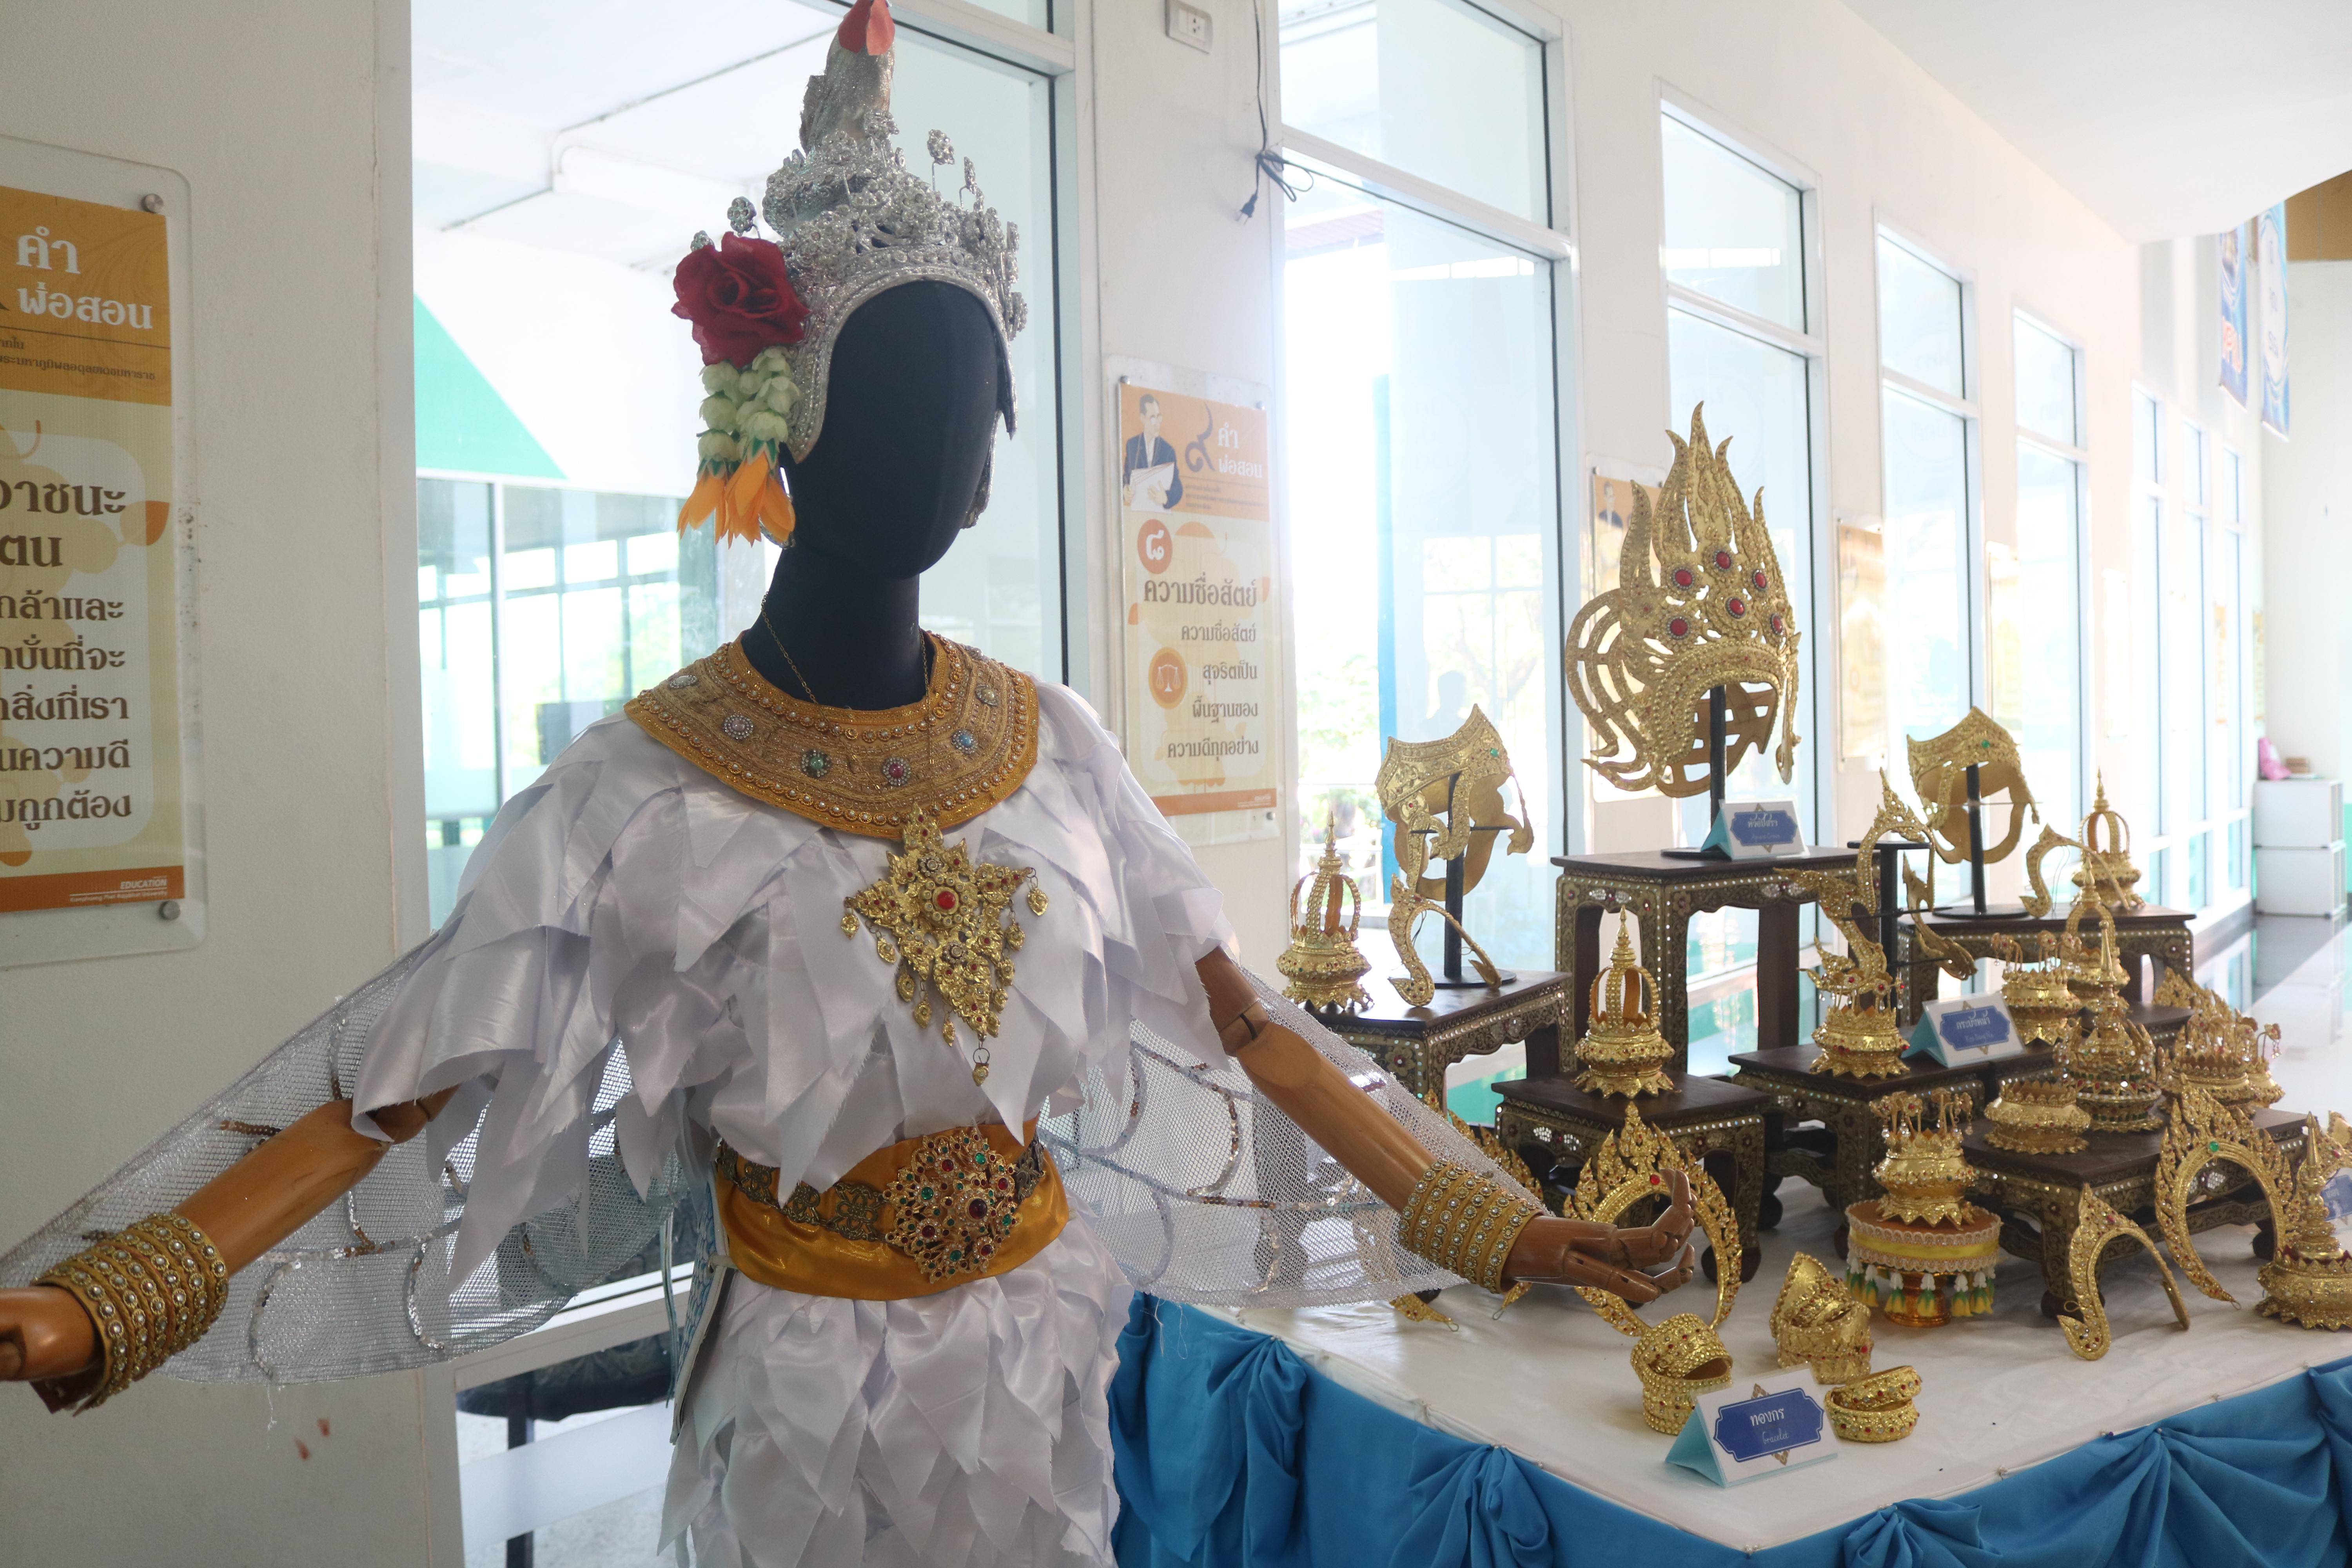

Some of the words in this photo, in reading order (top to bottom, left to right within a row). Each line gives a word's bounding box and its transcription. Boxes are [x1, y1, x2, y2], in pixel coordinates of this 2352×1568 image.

[16, 226, 81, 274] คำ
[17, 281, 153, 329] พ่อสอน
[1218, 423, 1239, 448] คำ
[1219, 456, 1263, 479] พ่อสอน
[1144, 572, 1258, 607] ความซื่อสัตย์
[1181, 619, 1256, 642] ความซื่อสัตย์
[1203, 660, 1257, 685] สุจริตเป็น
[1192, 695, 1258, 723] พื้นฐานของ
[1168, 736, 1259, 761] ความดีทุกอย่าง
[120, 878, 167, 890] EDUCATION
[1750, 1408, 1785, 1426] ทองกร
[1762, 1428, 1789, 1445] bracelet
